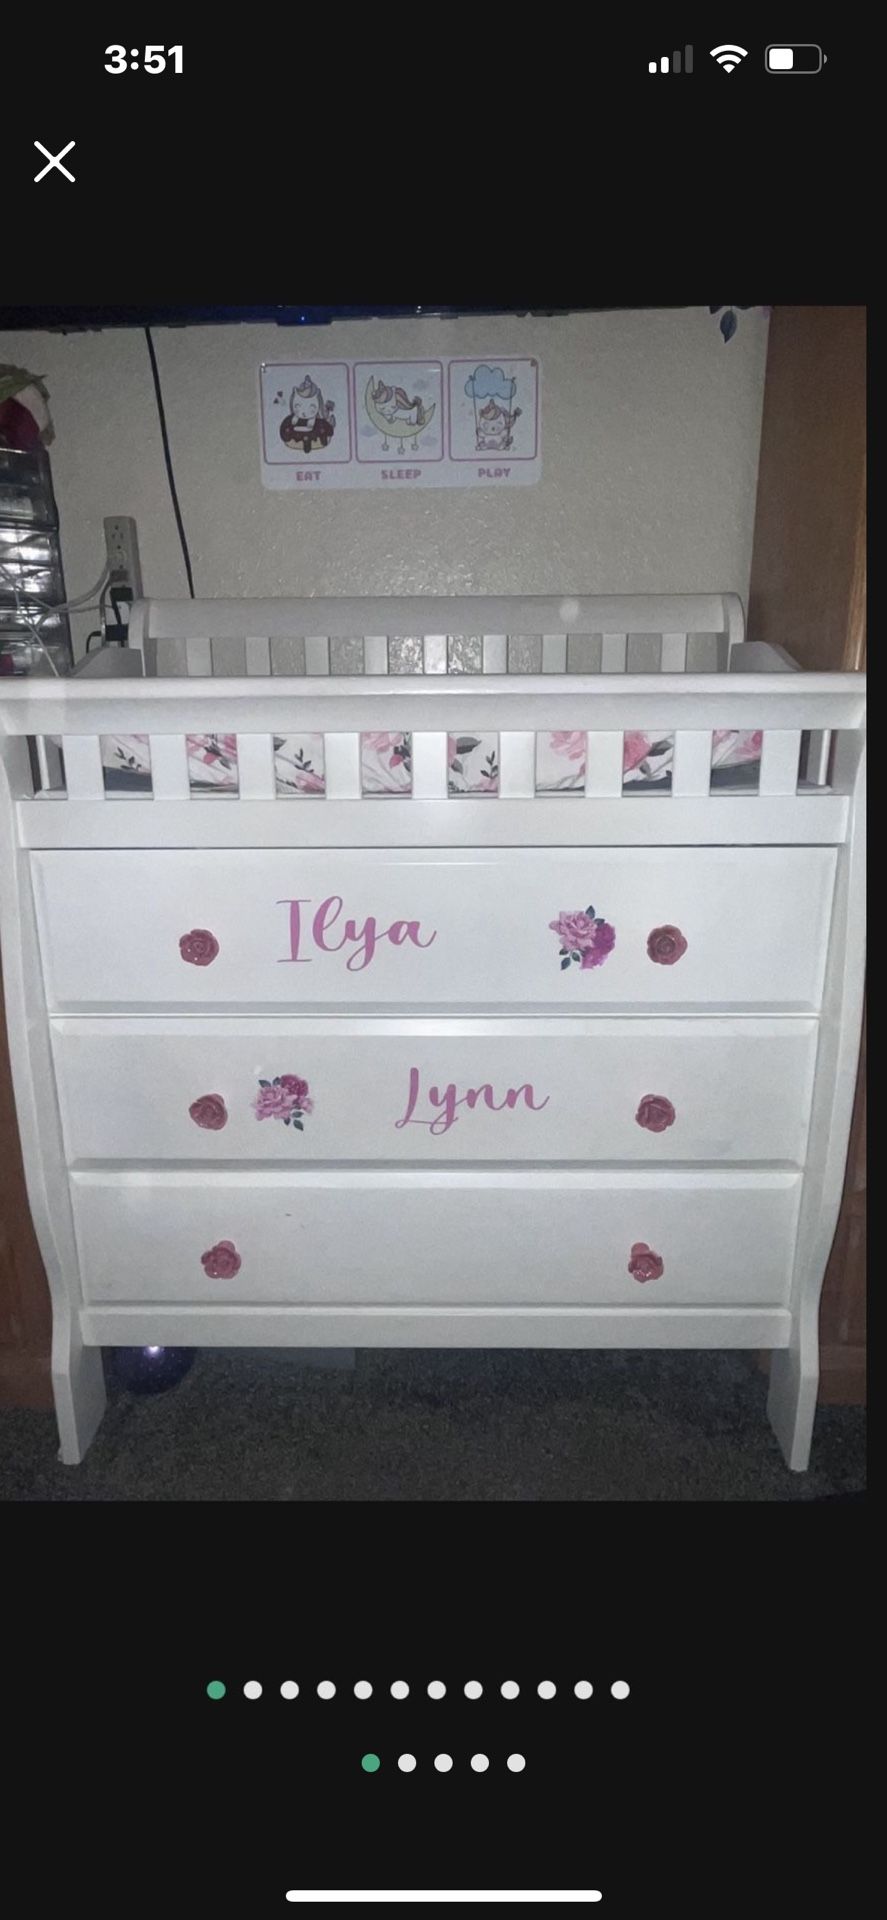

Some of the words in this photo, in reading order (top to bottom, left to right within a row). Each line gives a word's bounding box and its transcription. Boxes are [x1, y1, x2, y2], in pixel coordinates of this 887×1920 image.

[296, 471, 321, 481] EAT
[381, 469, 421, 480] SLEEP
[478, 467, 511, 478] PLAY
[276, 896, 437, 971] Ilya
[395, 1067, 550, 1135] Lynn
